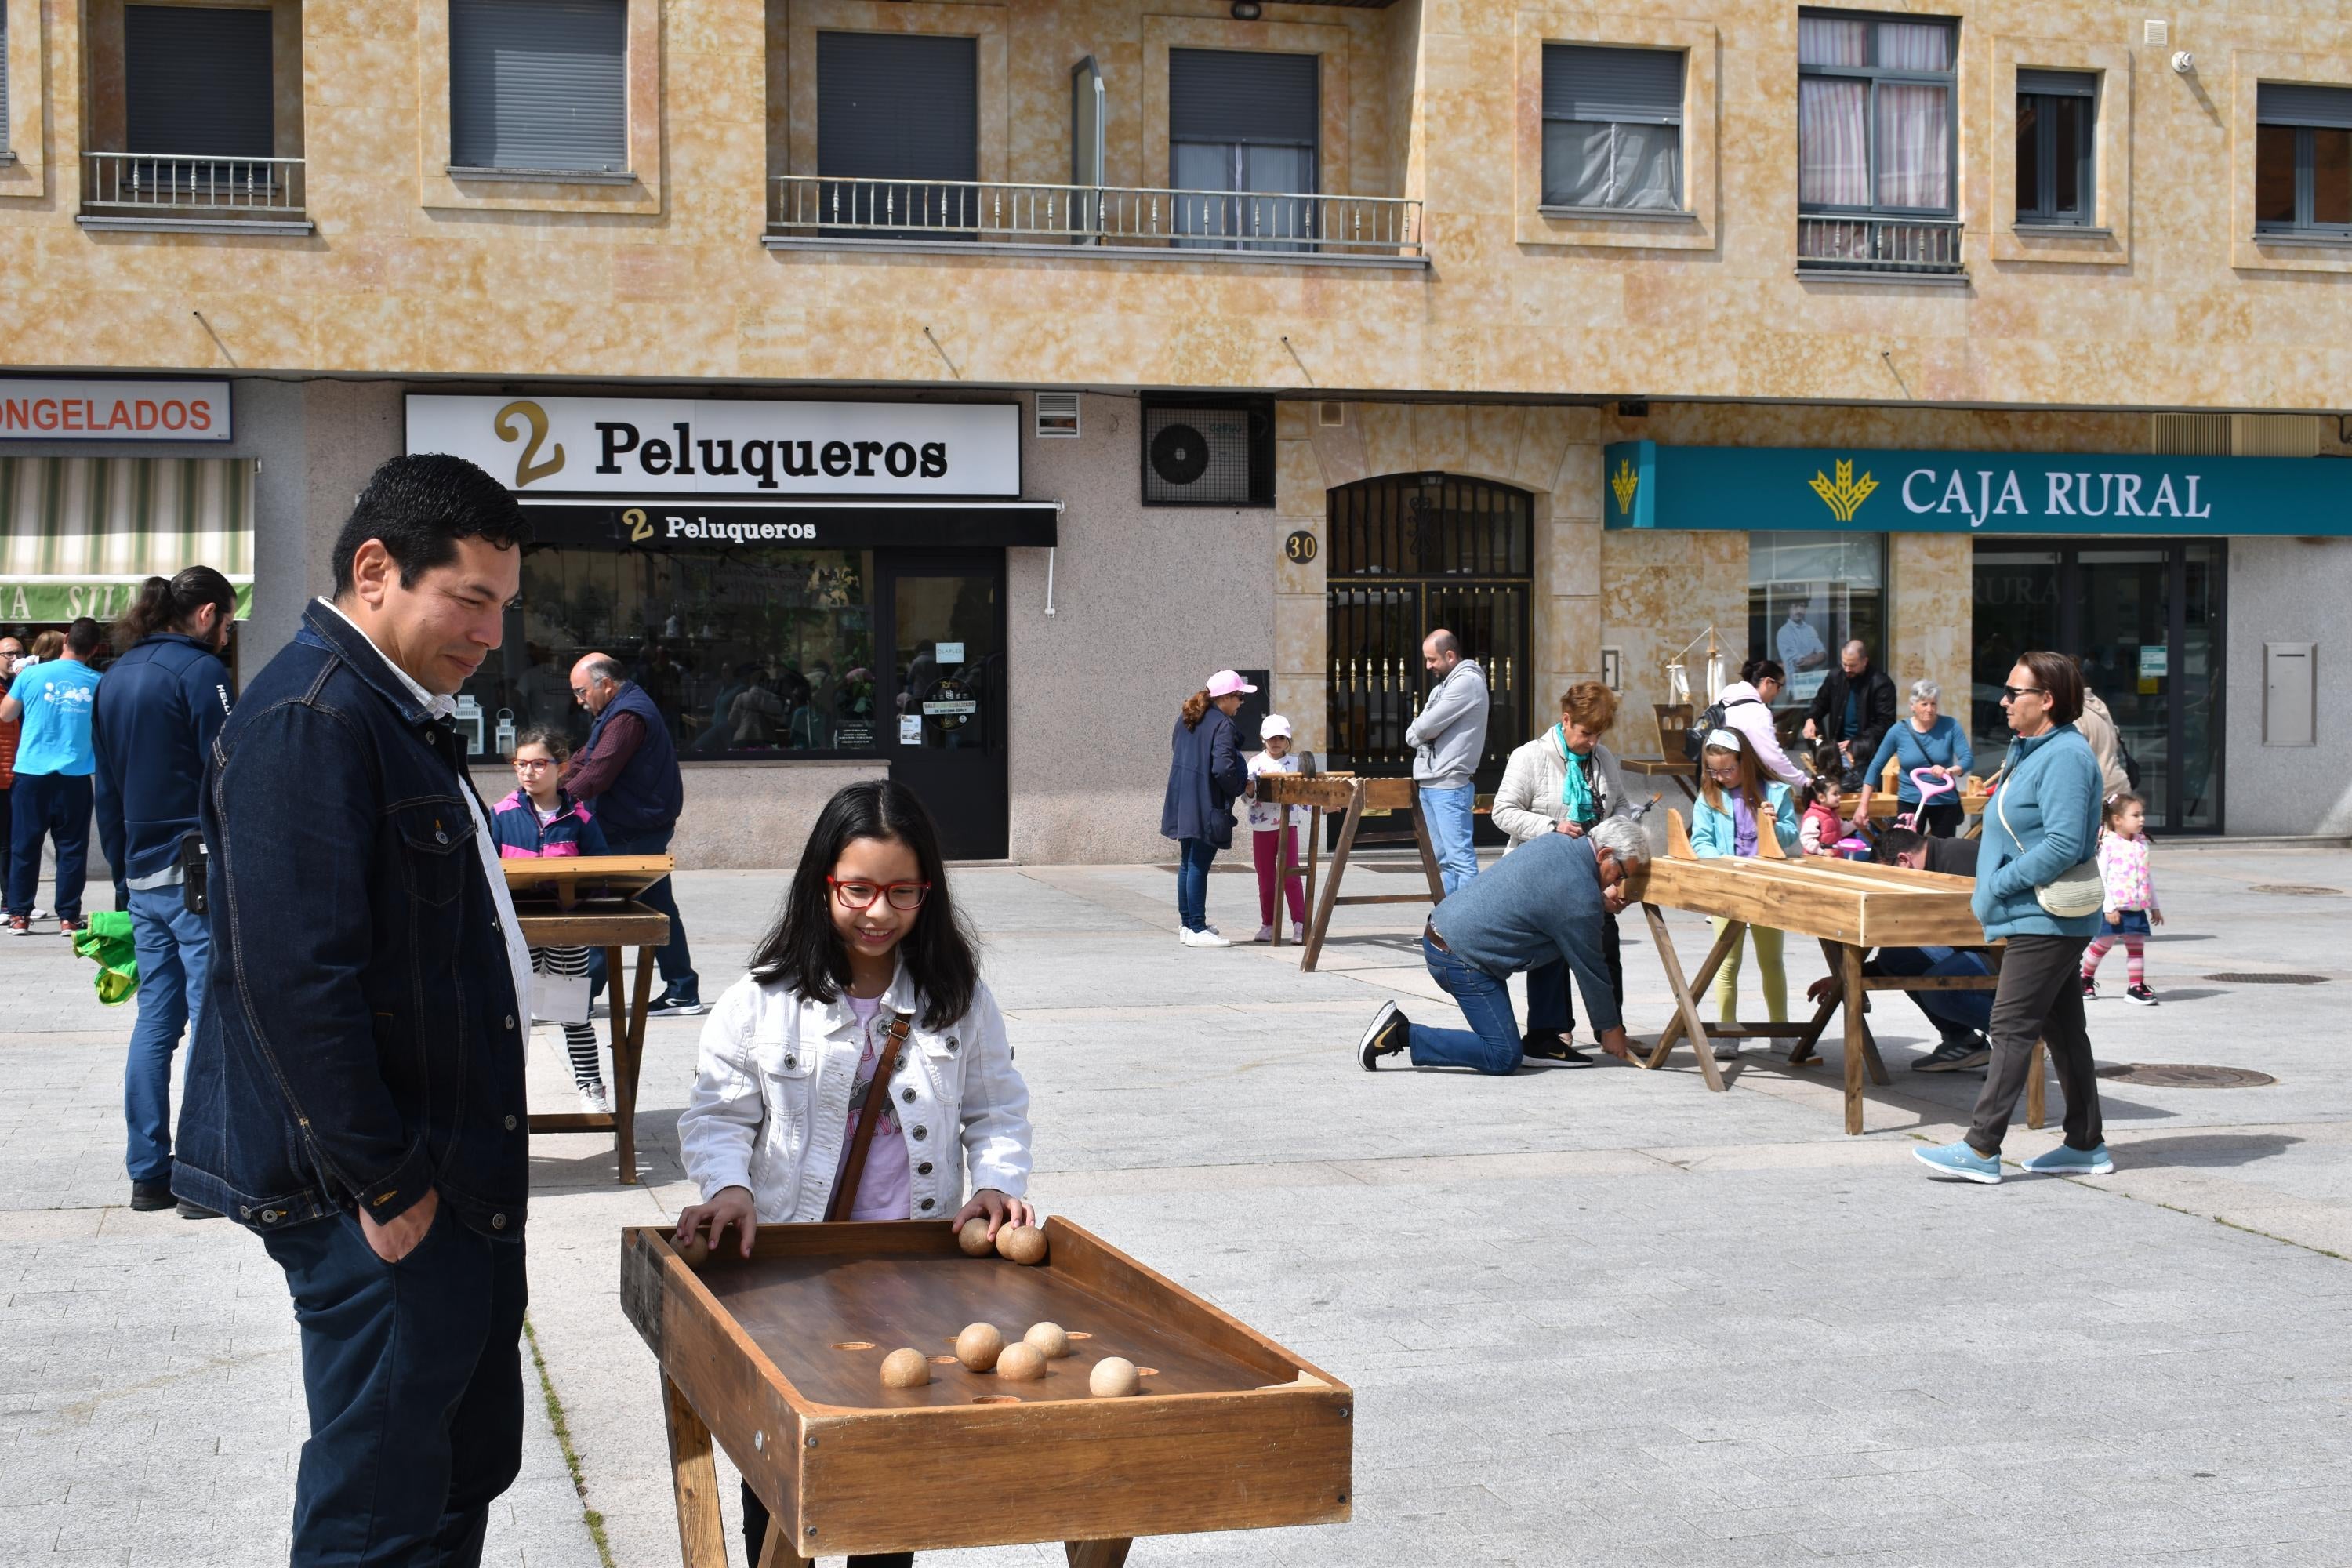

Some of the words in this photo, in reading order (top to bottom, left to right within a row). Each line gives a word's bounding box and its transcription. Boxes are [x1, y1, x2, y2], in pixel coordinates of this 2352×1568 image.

[0, 398, 212, 430] NGELADOS
[495, 401, 565, 488] 2
[594, 422, 948, 488] Peluqueros
[1902, 469, 2029, 527] CAJA
[2045, 472, 2211, 518] RURAL
[622, 508, 654, 542] 2
[666, 517, 816, 543] Peluqueros
[1290, 536, 1316, 558] 30
